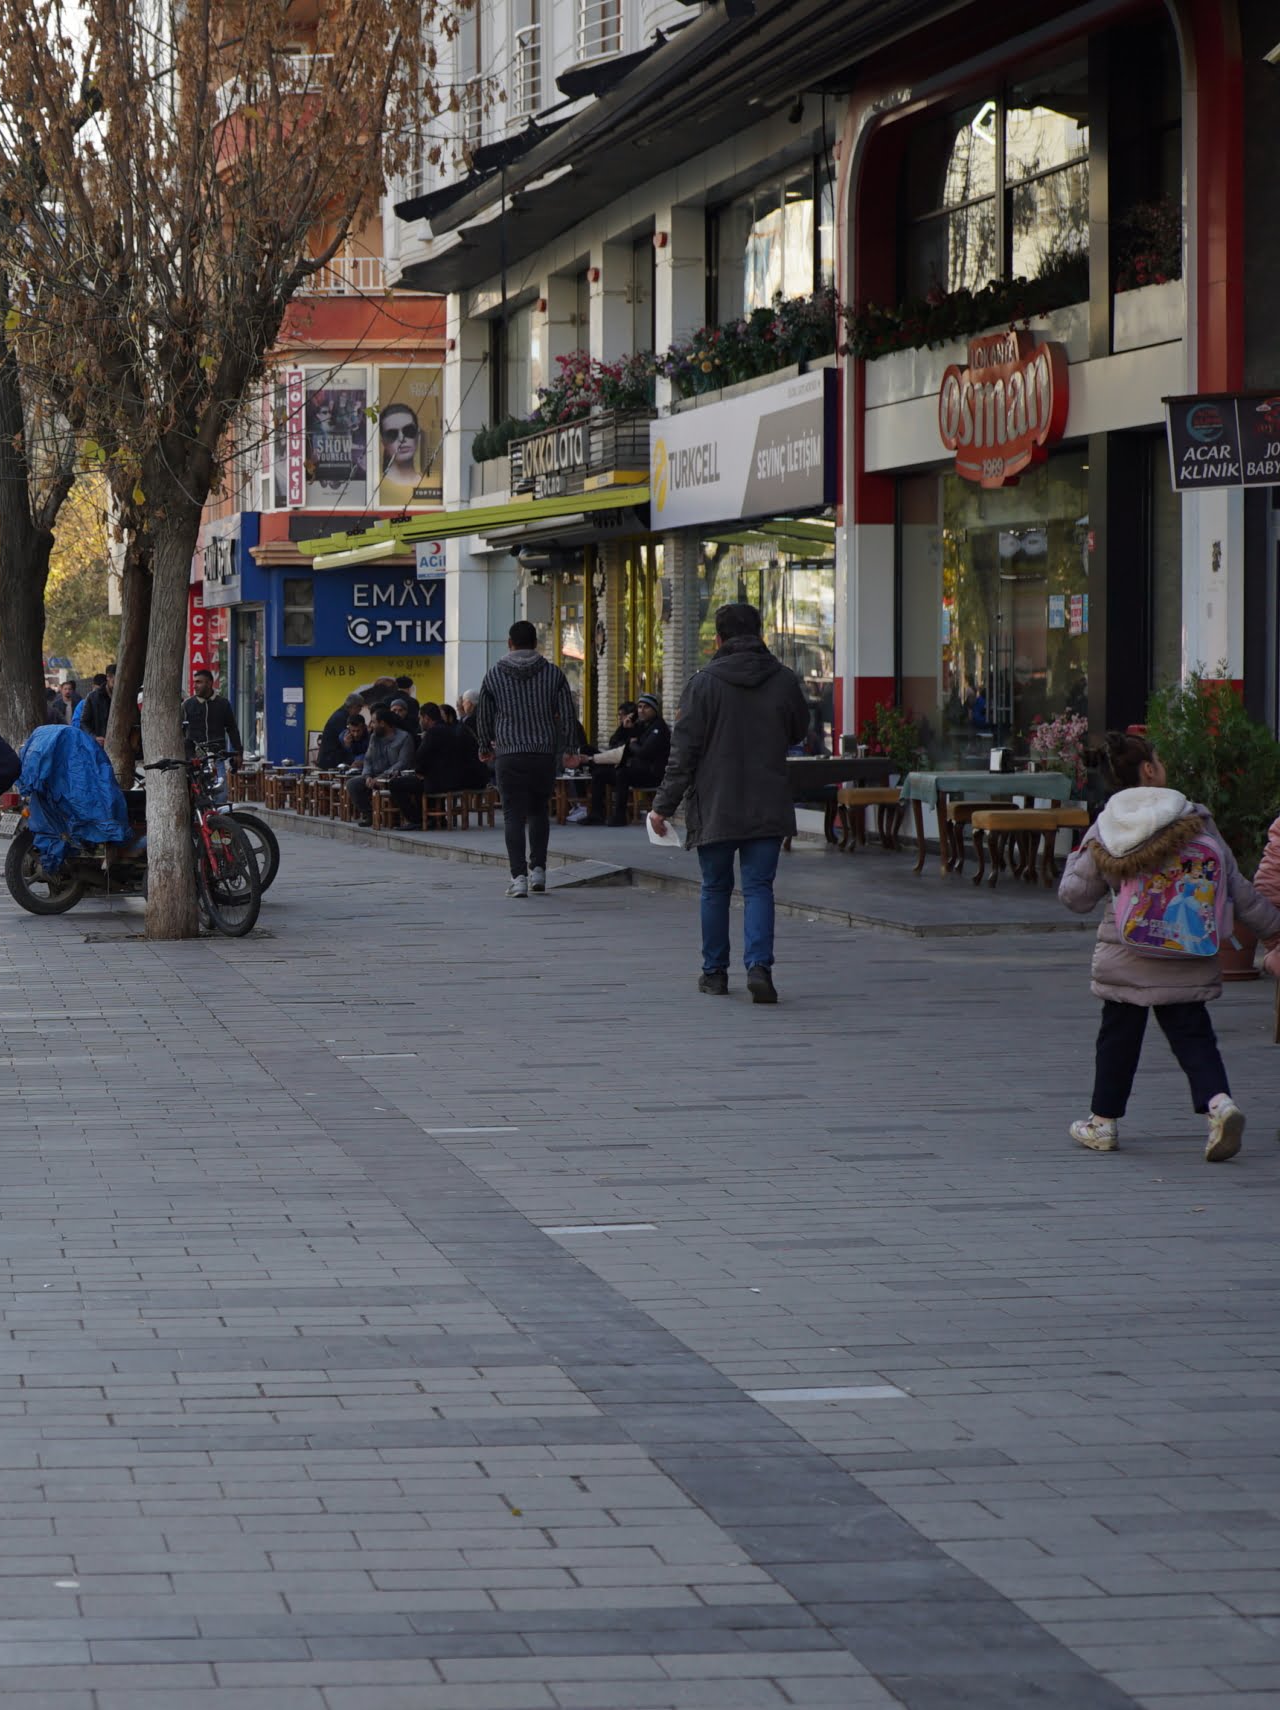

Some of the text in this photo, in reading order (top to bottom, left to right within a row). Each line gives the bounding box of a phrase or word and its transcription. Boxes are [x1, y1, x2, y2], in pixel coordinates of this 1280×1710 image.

[317, 439, 352, 453] SHOW
[1183, 445, 1231, 461] ACAR
[757, 428, 821, 483] SEVİNÇ İLETİŞİM
[668, 441, 720, 491] TURKCELL
[1246, 461, 1280, 476] BABY
[353, 580, 438, 607] EMAY
[324, 664, 356, 676] MBB
